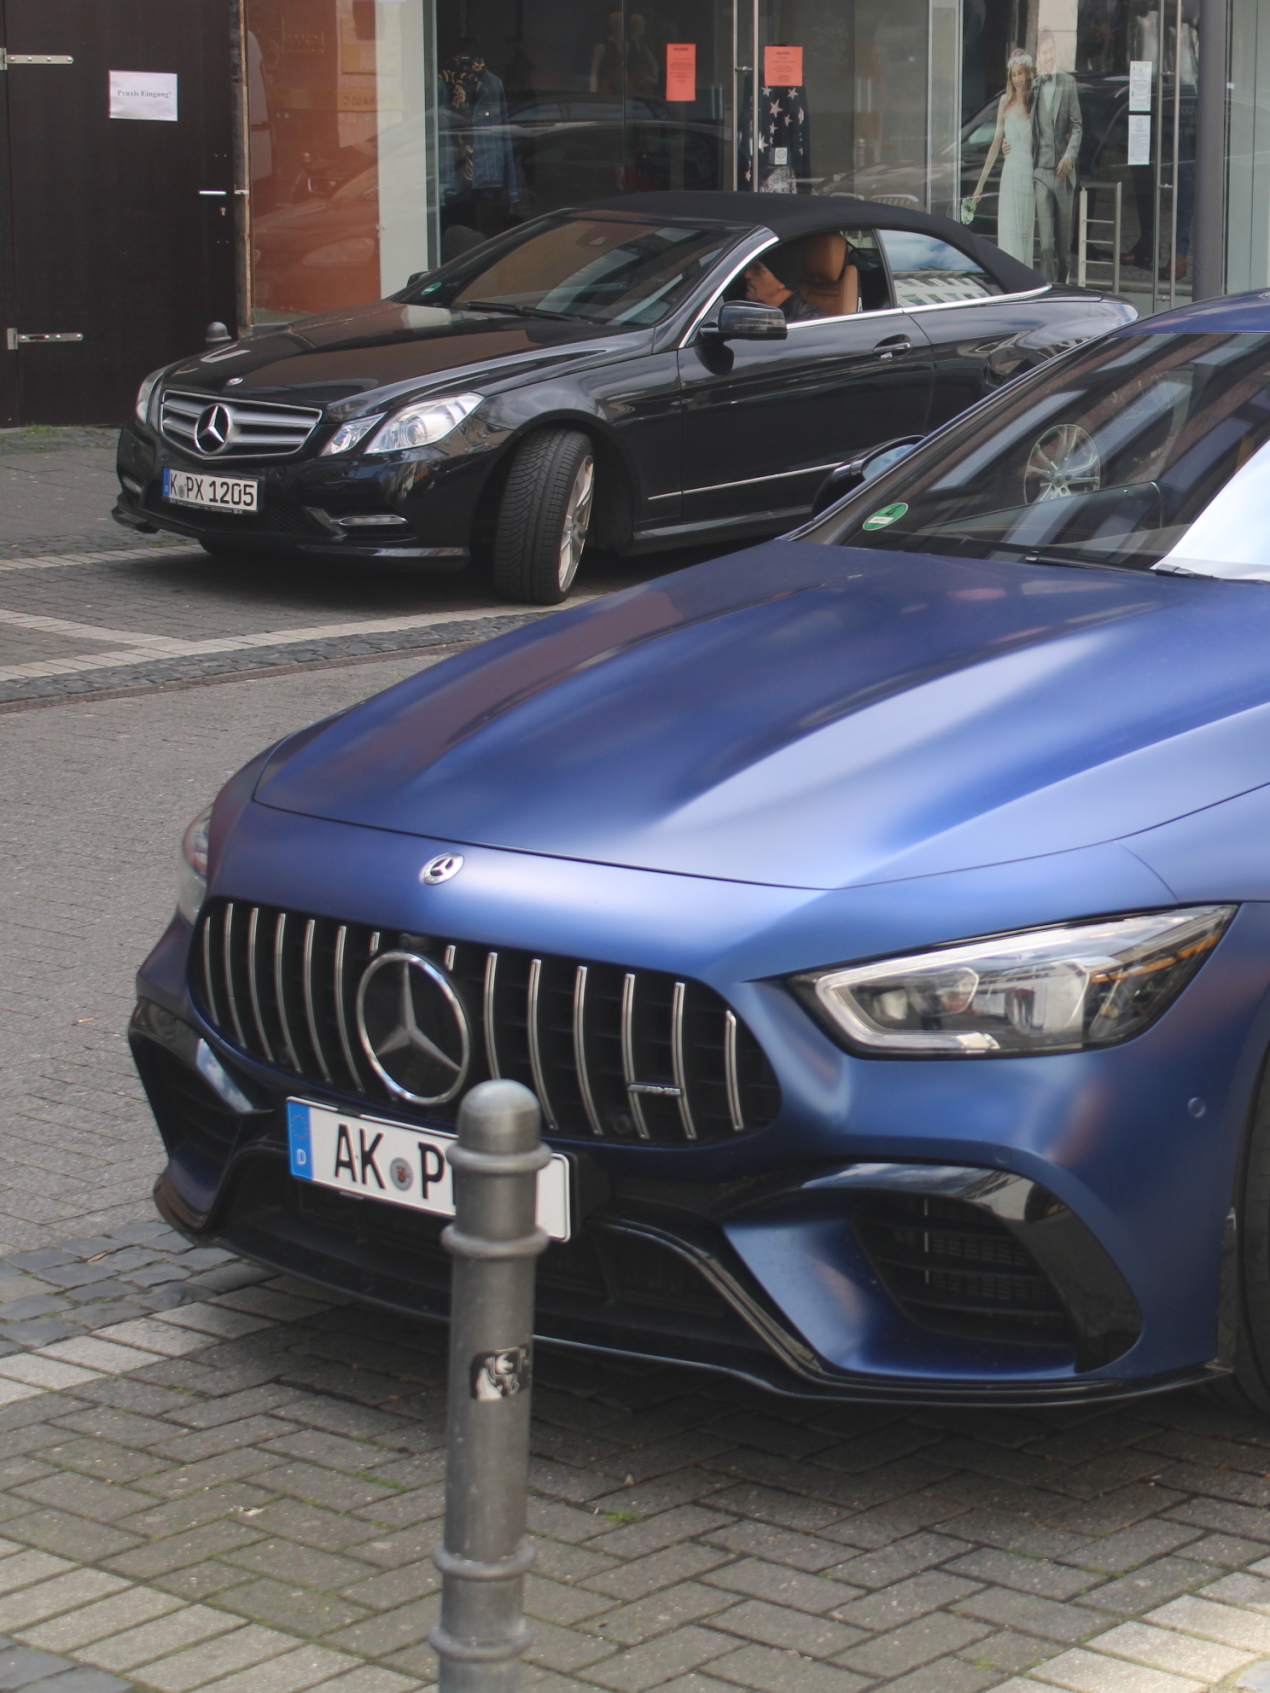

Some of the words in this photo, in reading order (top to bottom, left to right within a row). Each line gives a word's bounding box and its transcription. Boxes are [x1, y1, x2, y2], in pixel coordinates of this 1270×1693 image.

[141, 90, 172, 99] Eingang!
[170, 474, 178, 497] K
[186, 476, 205, 501] PX
[208, 480, 255, 507] 1205
[297, 1148, 307, 1166] D
[335, 1122, 387, 1190] AK
[418, 1140, 456, 1206] P
